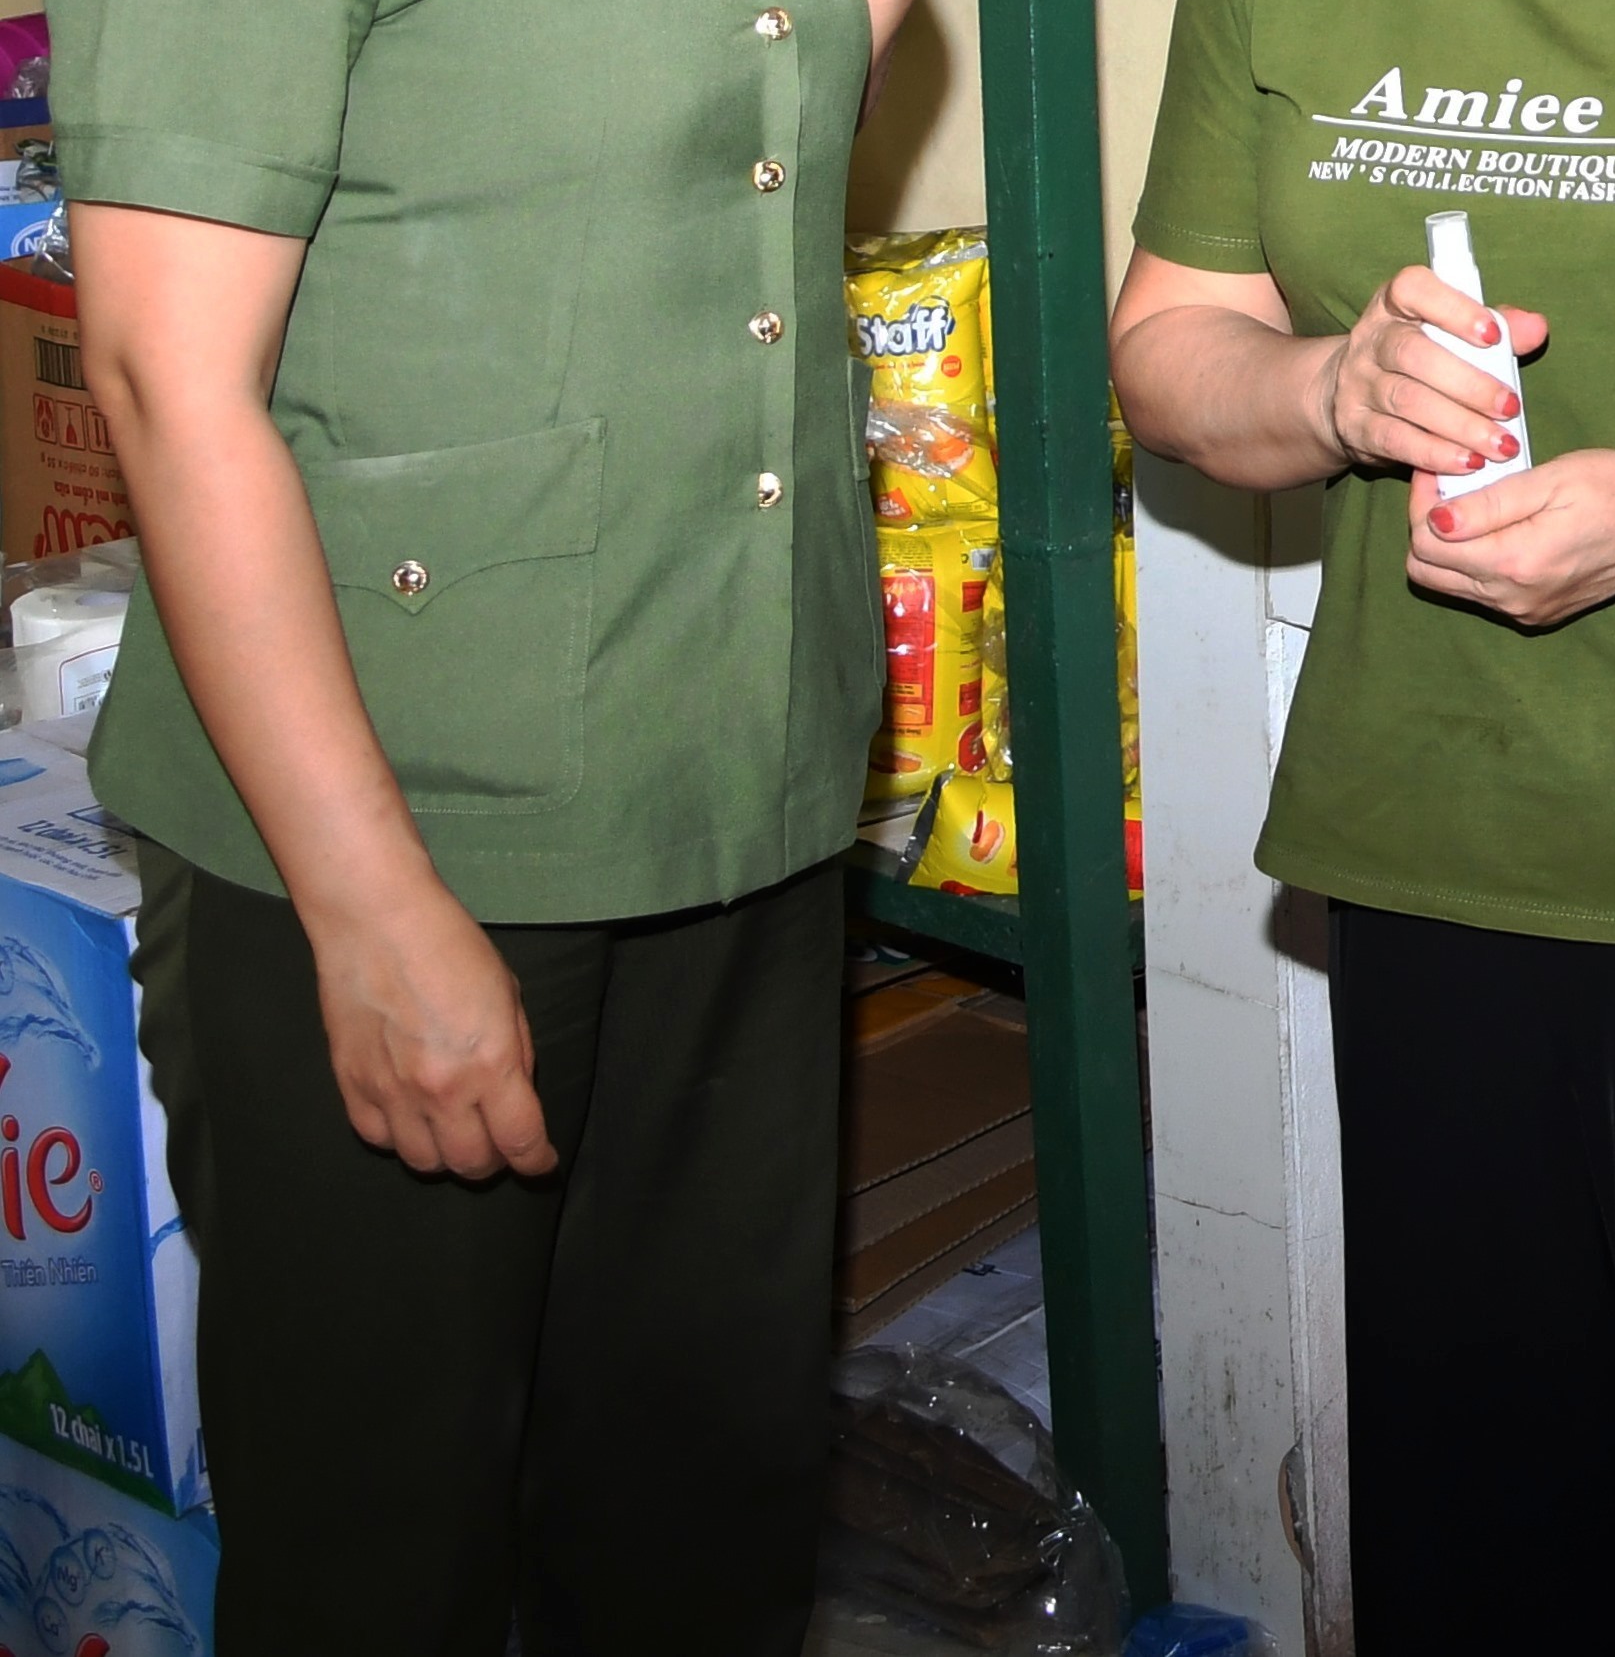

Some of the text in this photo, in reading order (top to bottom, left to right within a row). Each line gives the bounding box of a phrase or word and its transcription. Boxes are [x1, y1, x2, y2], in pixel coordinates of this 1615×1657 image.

[1331, 136, 1472, 172] MODERN
[1390, 167, 1554, 200] COLLECTION
[855, 304, 948, 358] Staff
[0, 1054, 93, 1241] ie
[1, 1254, 98, 1289] Thiên Nhiên
[50, 1402, 70, 1440] 12
[71, 1414, 103, 1455] chai
[104, 1439, 116, 1462] x
